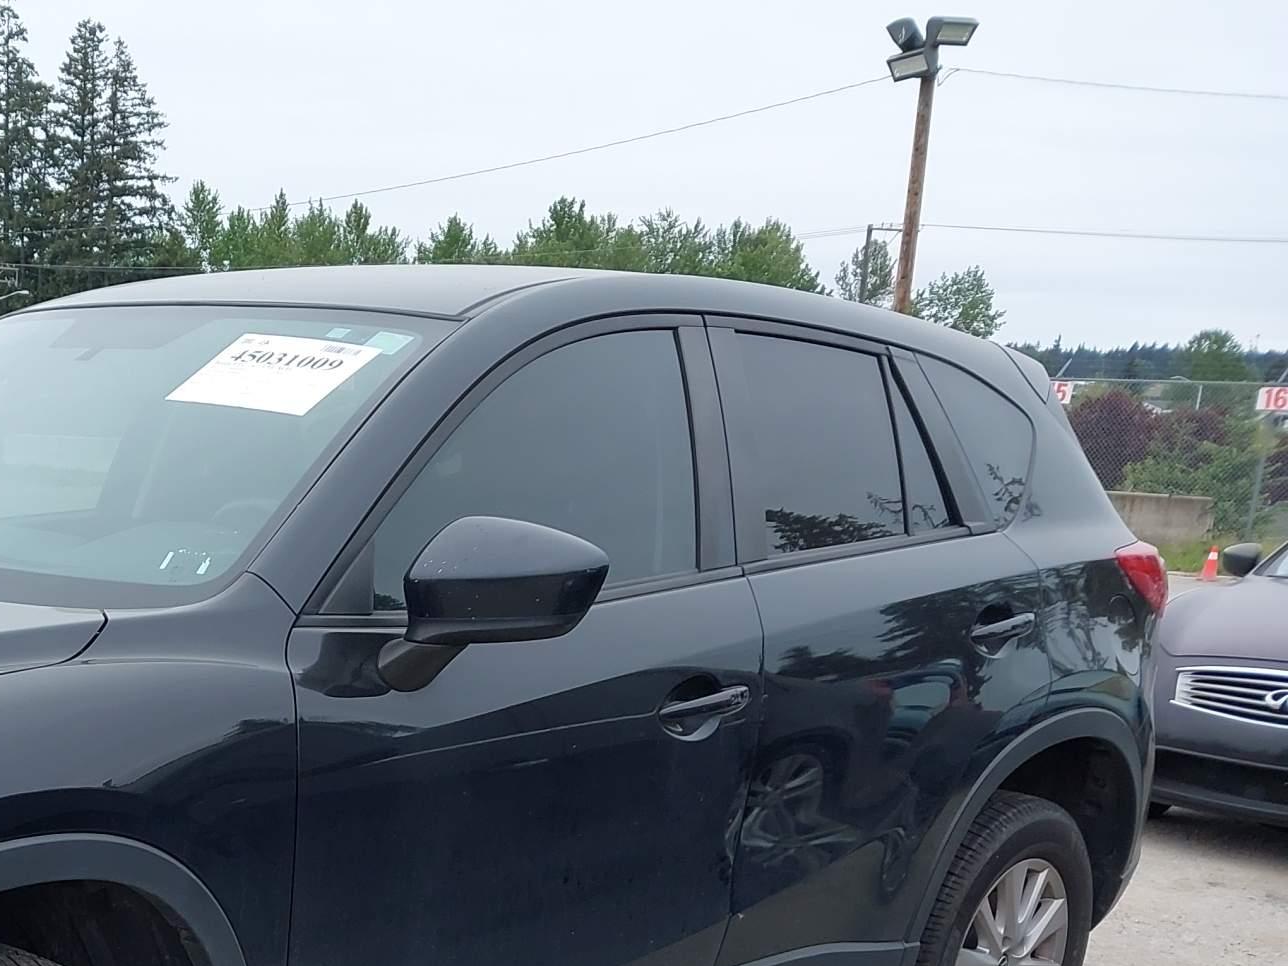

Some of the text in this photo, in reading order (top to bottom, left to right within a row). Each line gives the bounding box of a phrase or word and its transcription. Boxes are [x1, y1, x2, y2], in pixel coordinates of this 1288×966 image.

[230, 349, 344, 370] 45031009
[1054, 383, 1068, 402] 5
[1263, 386, 1288, 404] 16
